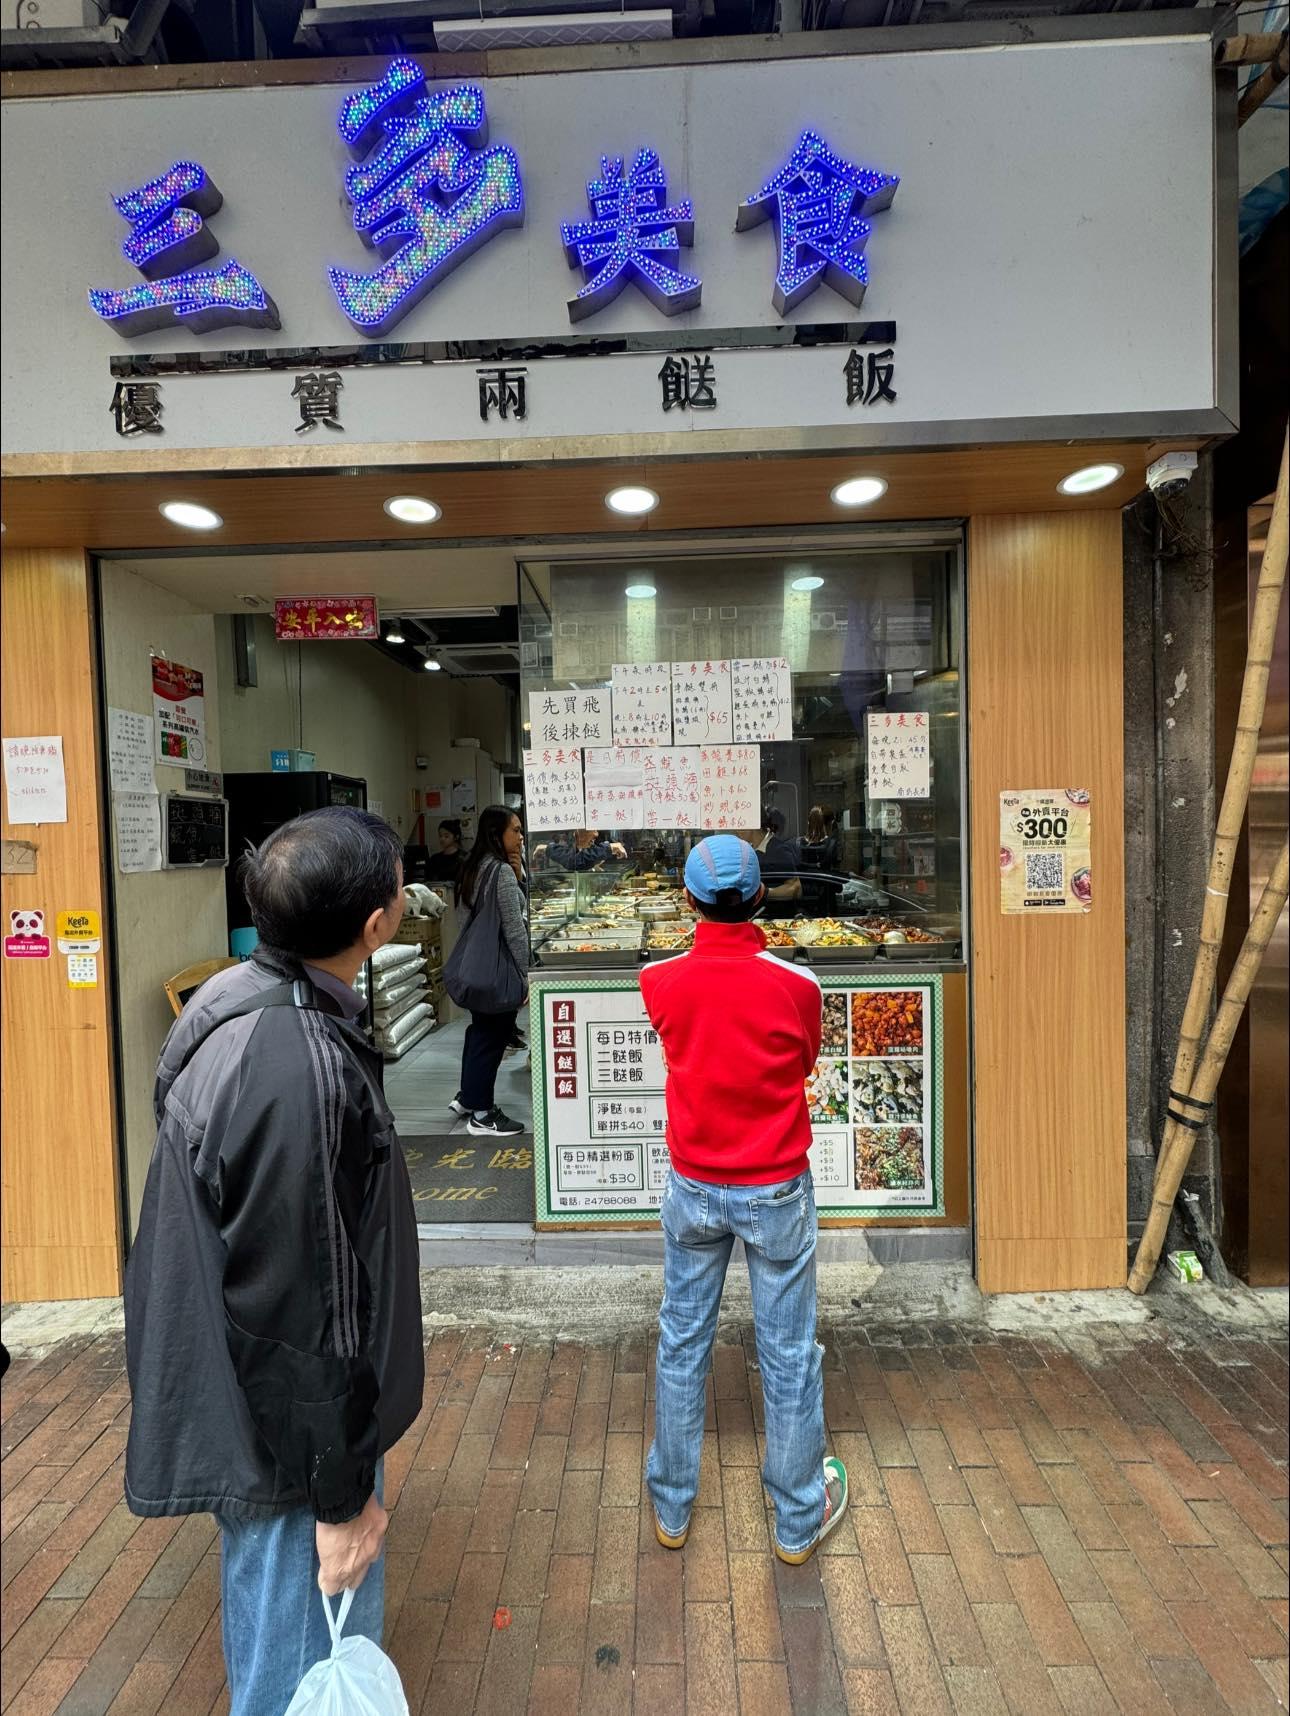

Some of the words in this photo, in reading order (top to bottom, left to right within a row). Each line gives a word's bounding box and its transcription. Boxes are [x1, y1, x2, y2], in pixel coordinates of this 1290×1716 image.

[88, 57, 899, 333] 三多美食
[109, 348, 897, 437] 優質兩餸飯
[673, 661, 730, 676] 三多美食
[542, 695, 600, 715] 先買飛
[709, 711, 729, 724] $65
[870, 714, 927, 728] 三多美食
[525, 748, 580, 767] 三多美食
[1016, 818, 1068, 839] $300
[67, 916, 89, 928] KeeTa
[597, 1030, 658, 1045] 每日特價
[557, 1002, 575, 1096] 自選餸飯
[597, 1049, 643, 1063] 二餸飯
[598, 1068, 643, 1082] 三餸飯
[597, 1120, 645, 1131] 單拼$40
[652, 1119, 668, 1131] 雙
[563, 1150, 635, 1162] 每日精選粉面
[609, 1173, 636, 1184] $30
[584, 1196, 637, 1205] 24788088
